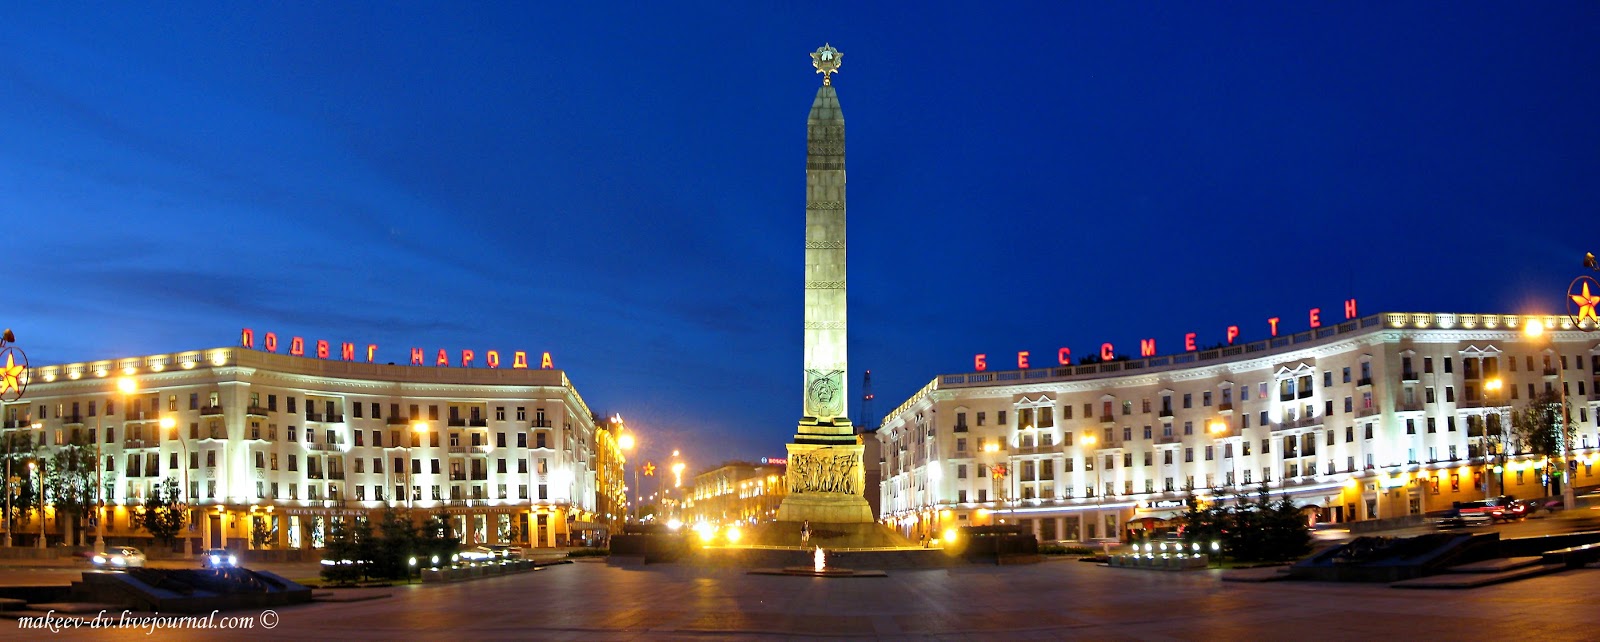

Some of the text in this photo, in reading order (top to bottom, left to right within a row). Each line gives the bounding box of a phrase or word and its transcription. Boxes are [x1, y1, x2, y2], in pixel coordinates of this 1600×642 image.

[241, 328, 554, 369] ПОДВИГ НАРОДА
[974, 298, 1357, 371] БЕССМЕРТЕН
